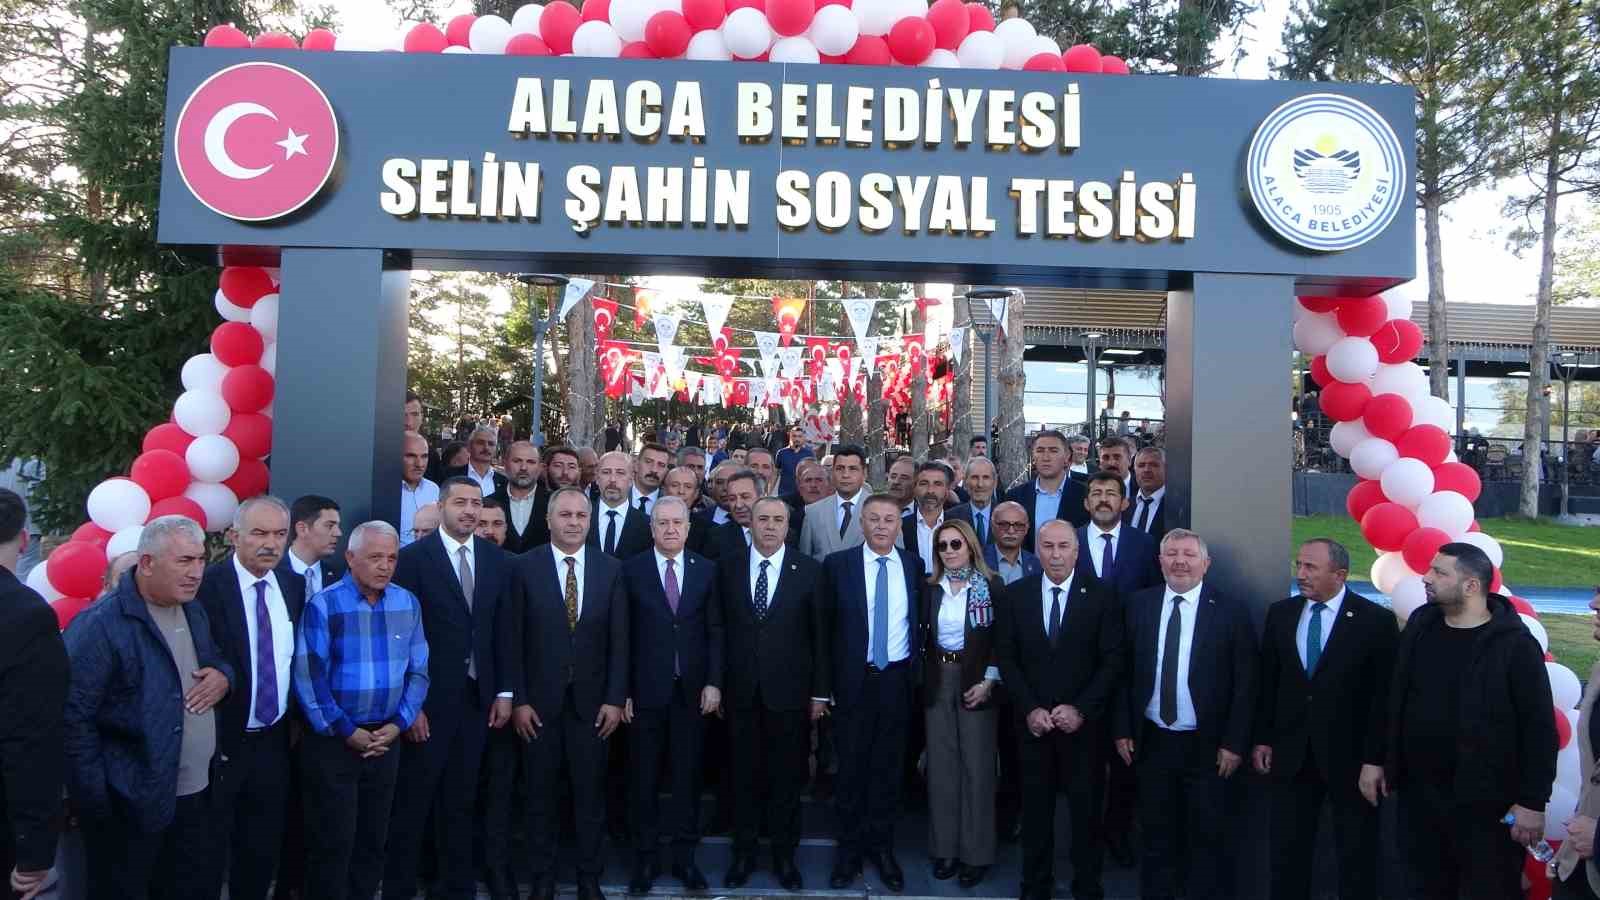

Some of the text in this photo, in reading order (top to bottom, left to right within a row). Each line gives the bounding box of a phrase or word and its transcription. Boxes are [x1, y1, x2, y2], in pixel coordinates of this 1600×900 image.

[508, 77, 1081, 149] ALACA BELEDİYESİ
[380, 151, 1197, 239] SELİN ŞAHİN SOSYAL TESİSİ
[1264, 175, 1302, 225] ALACA
[1312, 204, 1342, 216] 1905
